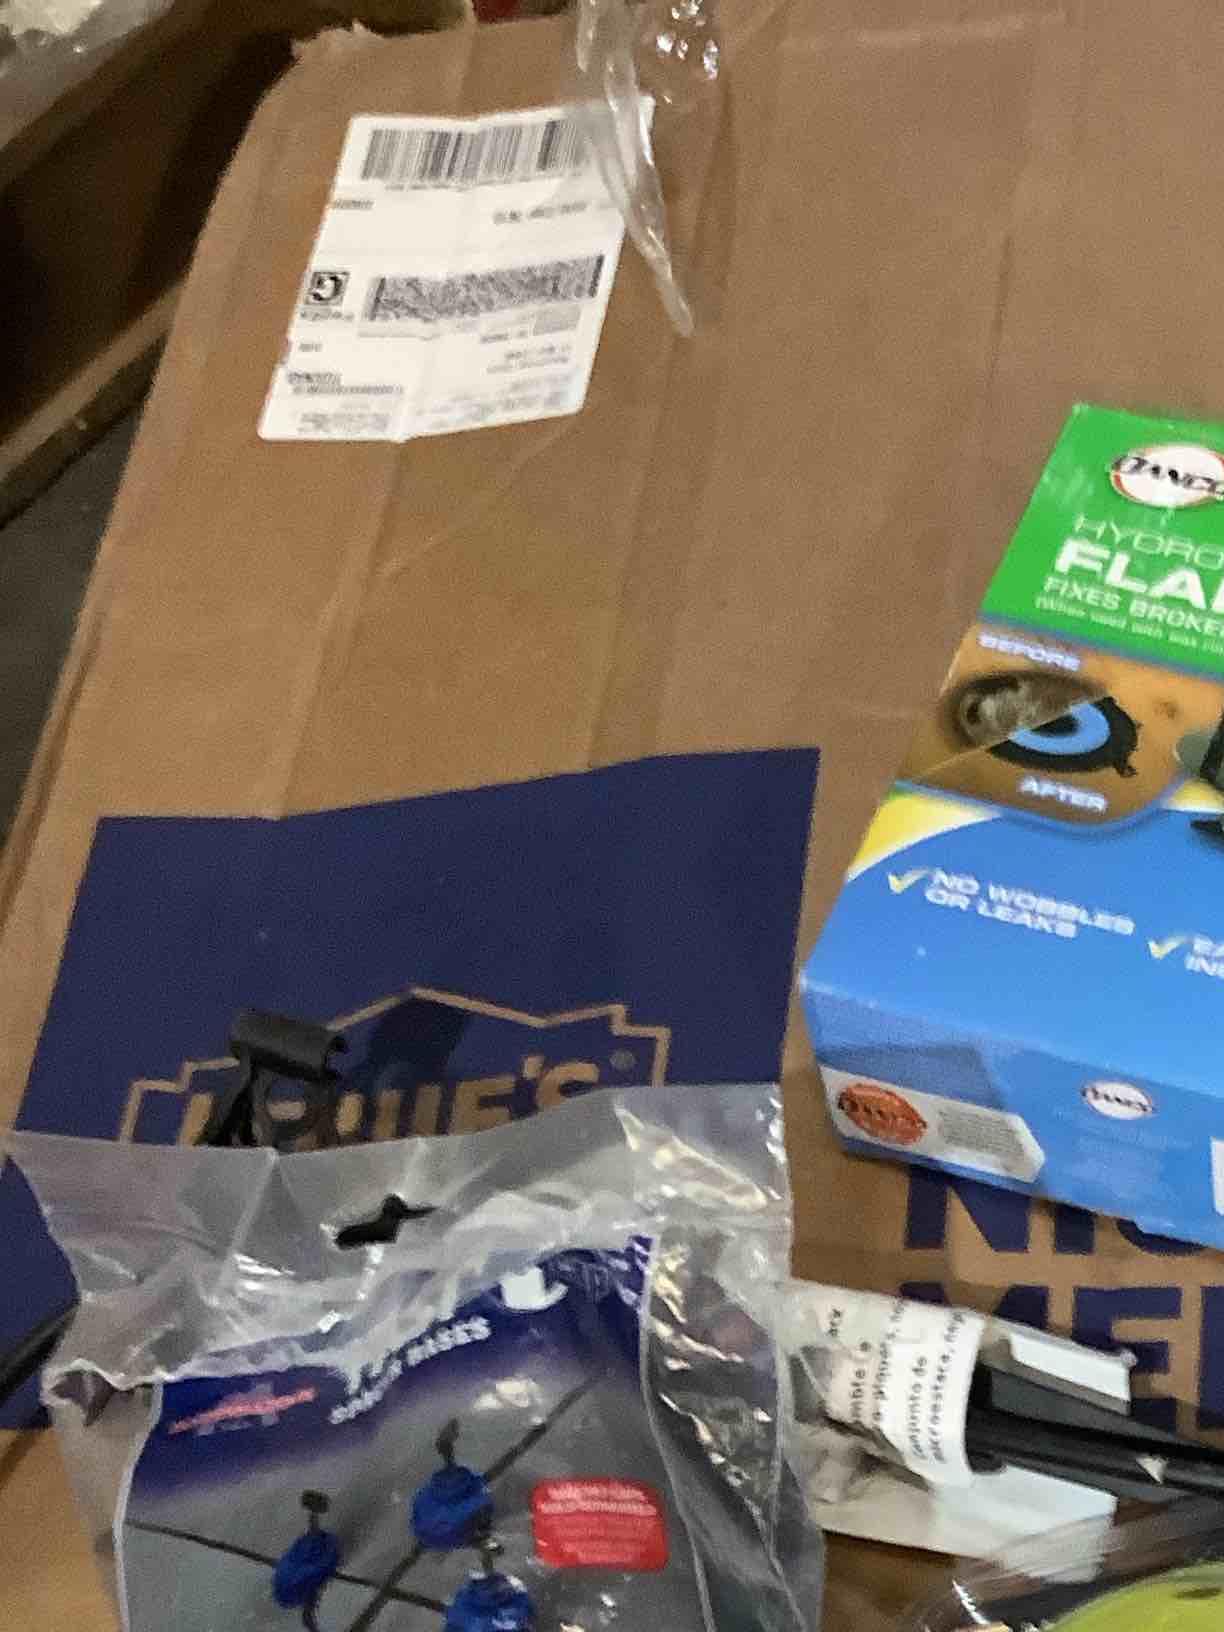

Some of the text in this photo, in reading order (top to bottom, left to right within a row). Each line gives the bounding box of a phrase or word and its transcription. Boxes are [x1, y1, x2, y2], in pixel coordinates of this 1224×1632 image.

[1043, 575, 1121, 613] FIXES
[978, 631, 1082, 672] BEFORE
[1017, 775, 1108, 814] AFTER
[924, 886, 1079, 940] OR LEAKS
[928, 868, 1136, 937] NO WOBBLES
